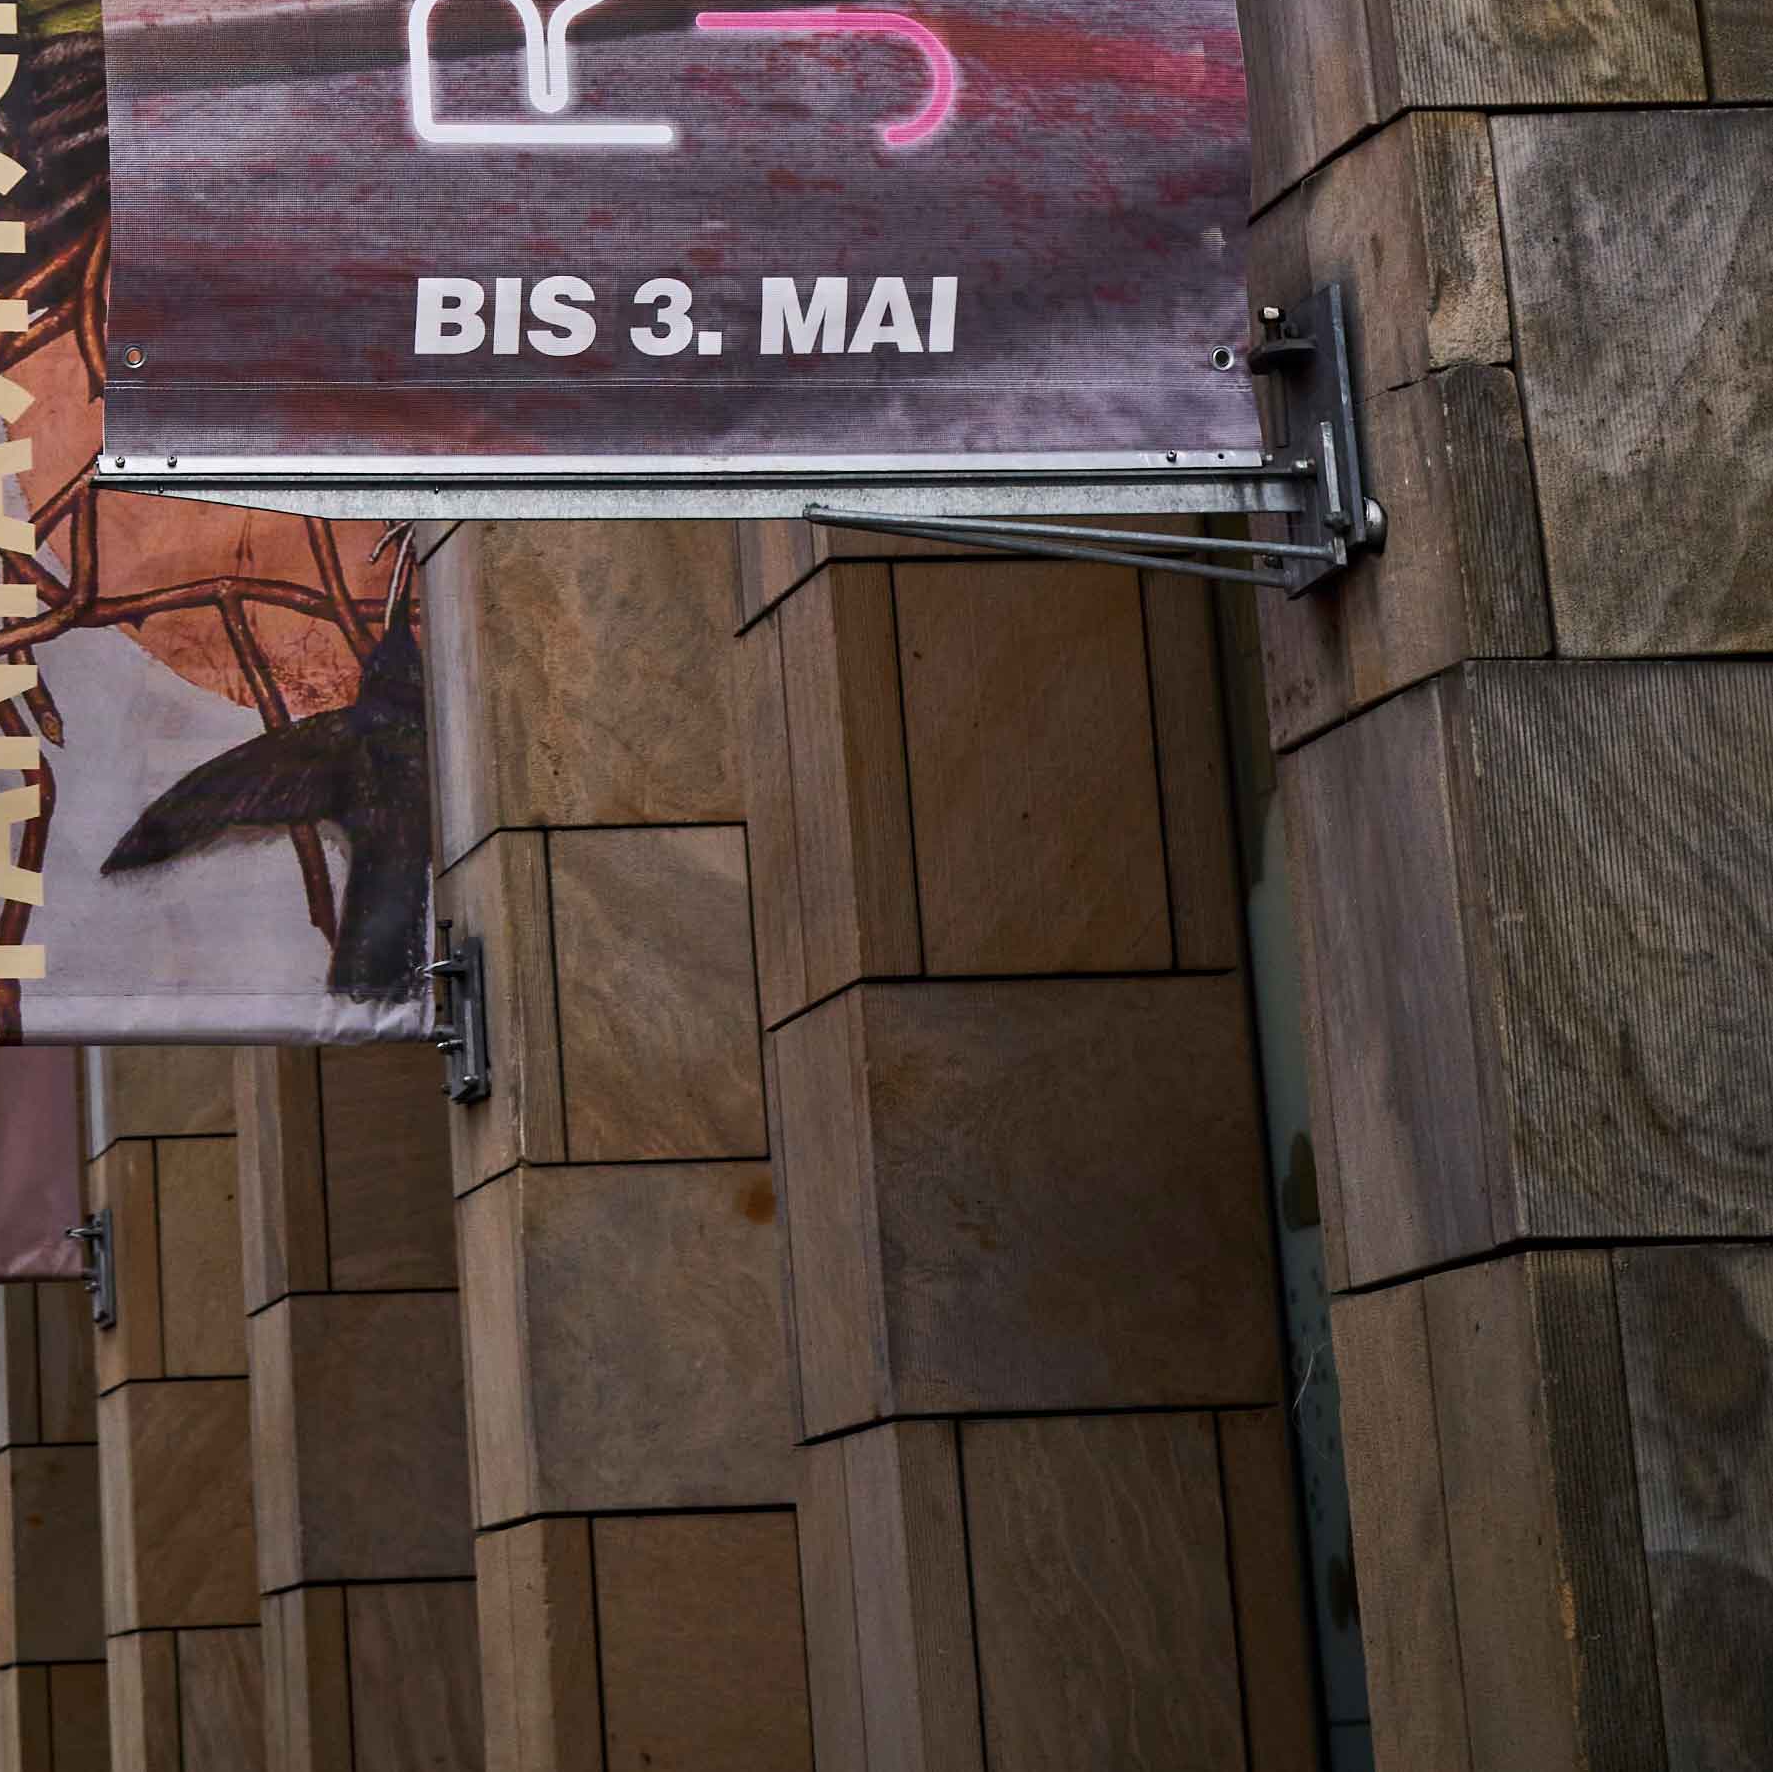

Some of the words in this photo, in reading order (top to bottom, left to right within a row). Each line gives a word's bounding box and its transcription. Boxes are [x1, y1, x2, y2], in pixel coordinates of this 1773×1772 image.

[414, 275, 597, 357] BIS
[629, 277, 723, 356] 3.
[760, 276, 959, 356] MAI
